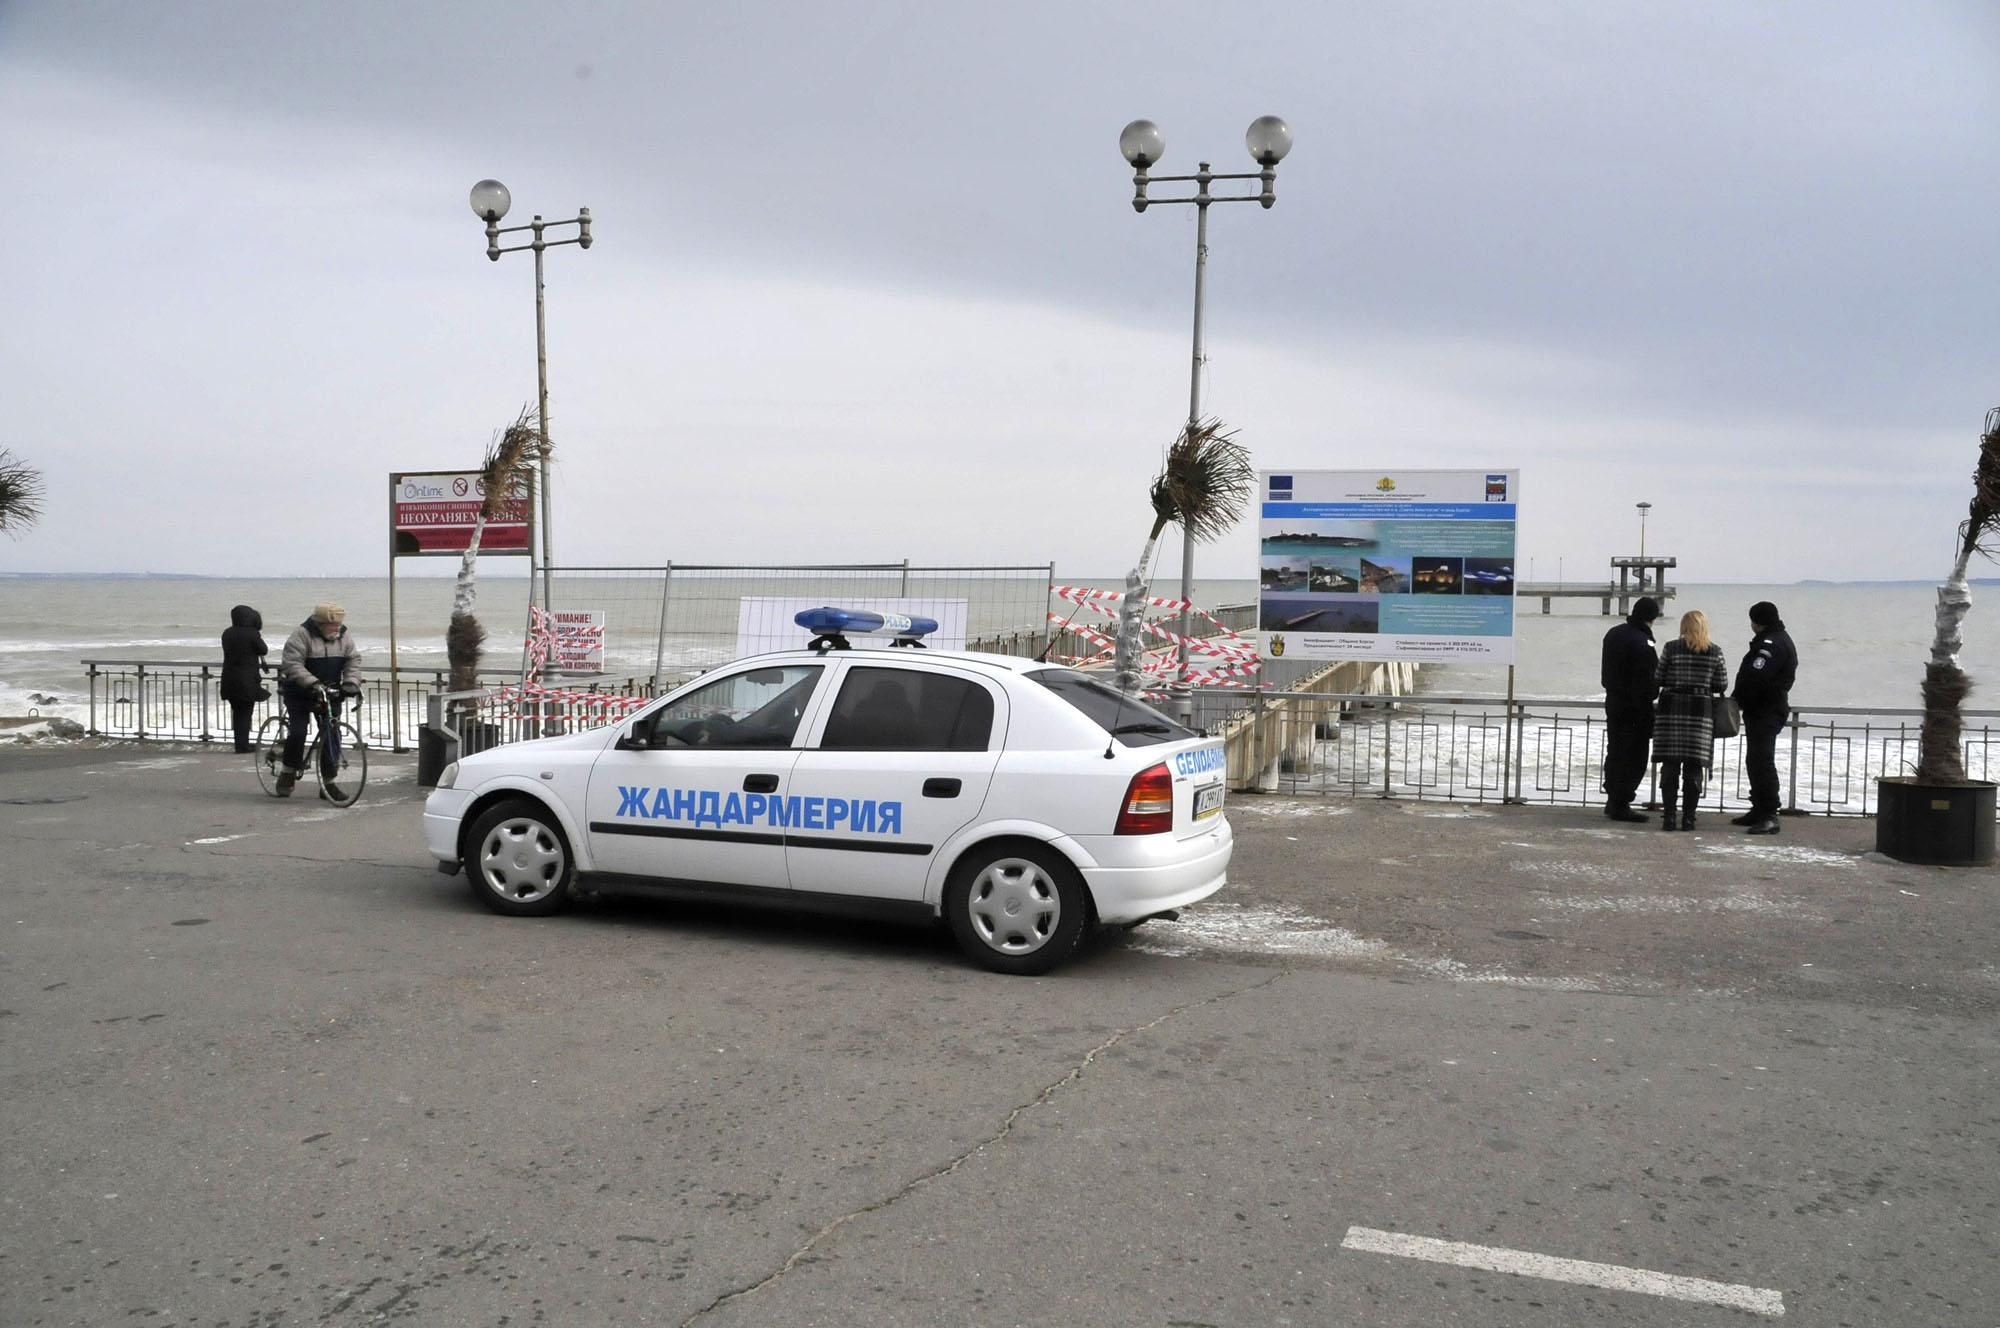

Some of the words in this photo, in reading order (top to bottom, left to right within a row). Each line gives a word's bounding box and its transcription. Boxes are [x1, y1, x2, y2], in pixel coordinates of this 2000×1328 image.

[401, 512, 481, 523] НЕОХРАНЯЕМ
[555, 613, 592, 623] ИМАНИЕ!
[616, 786, 903, 834] ЖАНДАРМЕРИЯ
